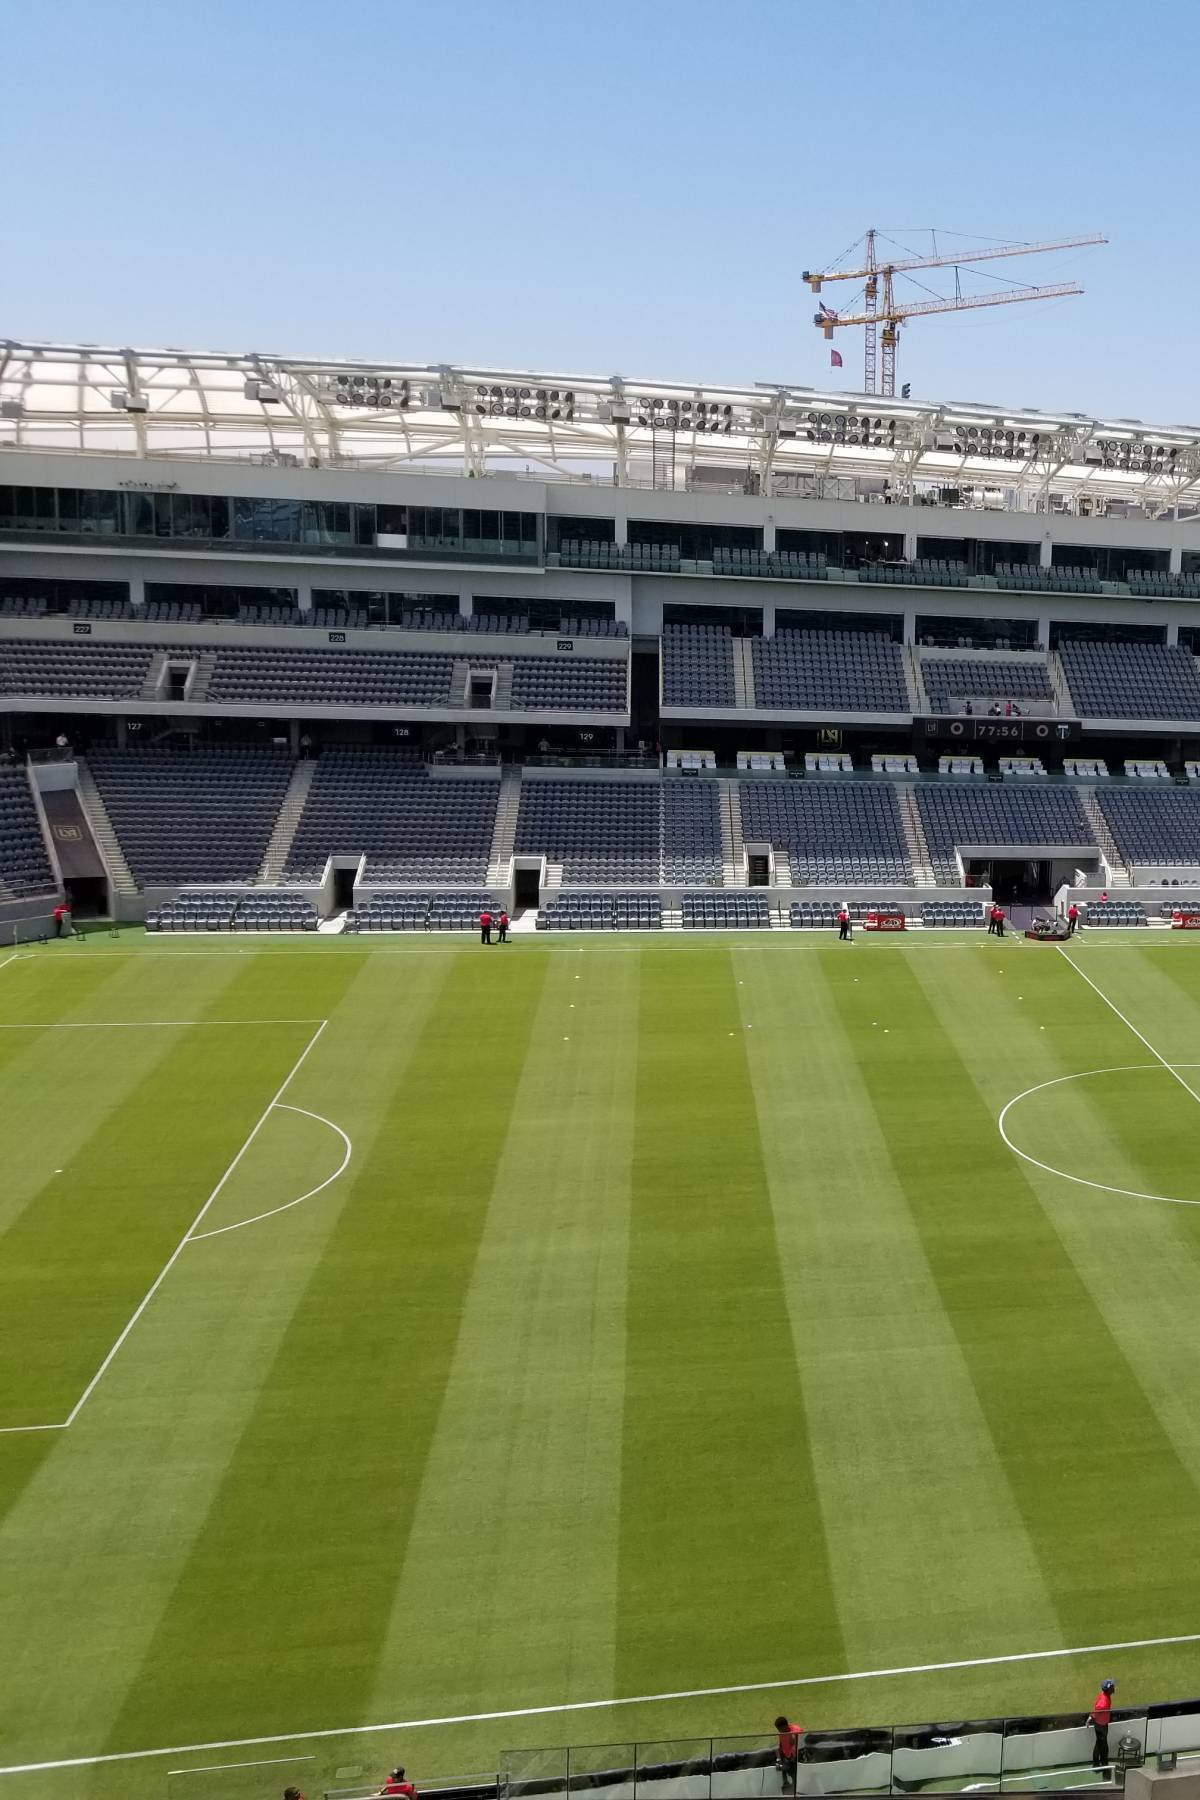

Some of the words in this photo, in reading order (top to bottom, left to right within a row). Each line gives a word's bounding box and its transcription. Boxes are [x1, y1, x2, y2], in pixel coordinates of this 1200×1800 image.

[128, 722, 142, 731] 127
[395, 728, 409, 736] 128
[978, 726, 1018, 737] 77:56
[580, 733, 594, 741] 129
